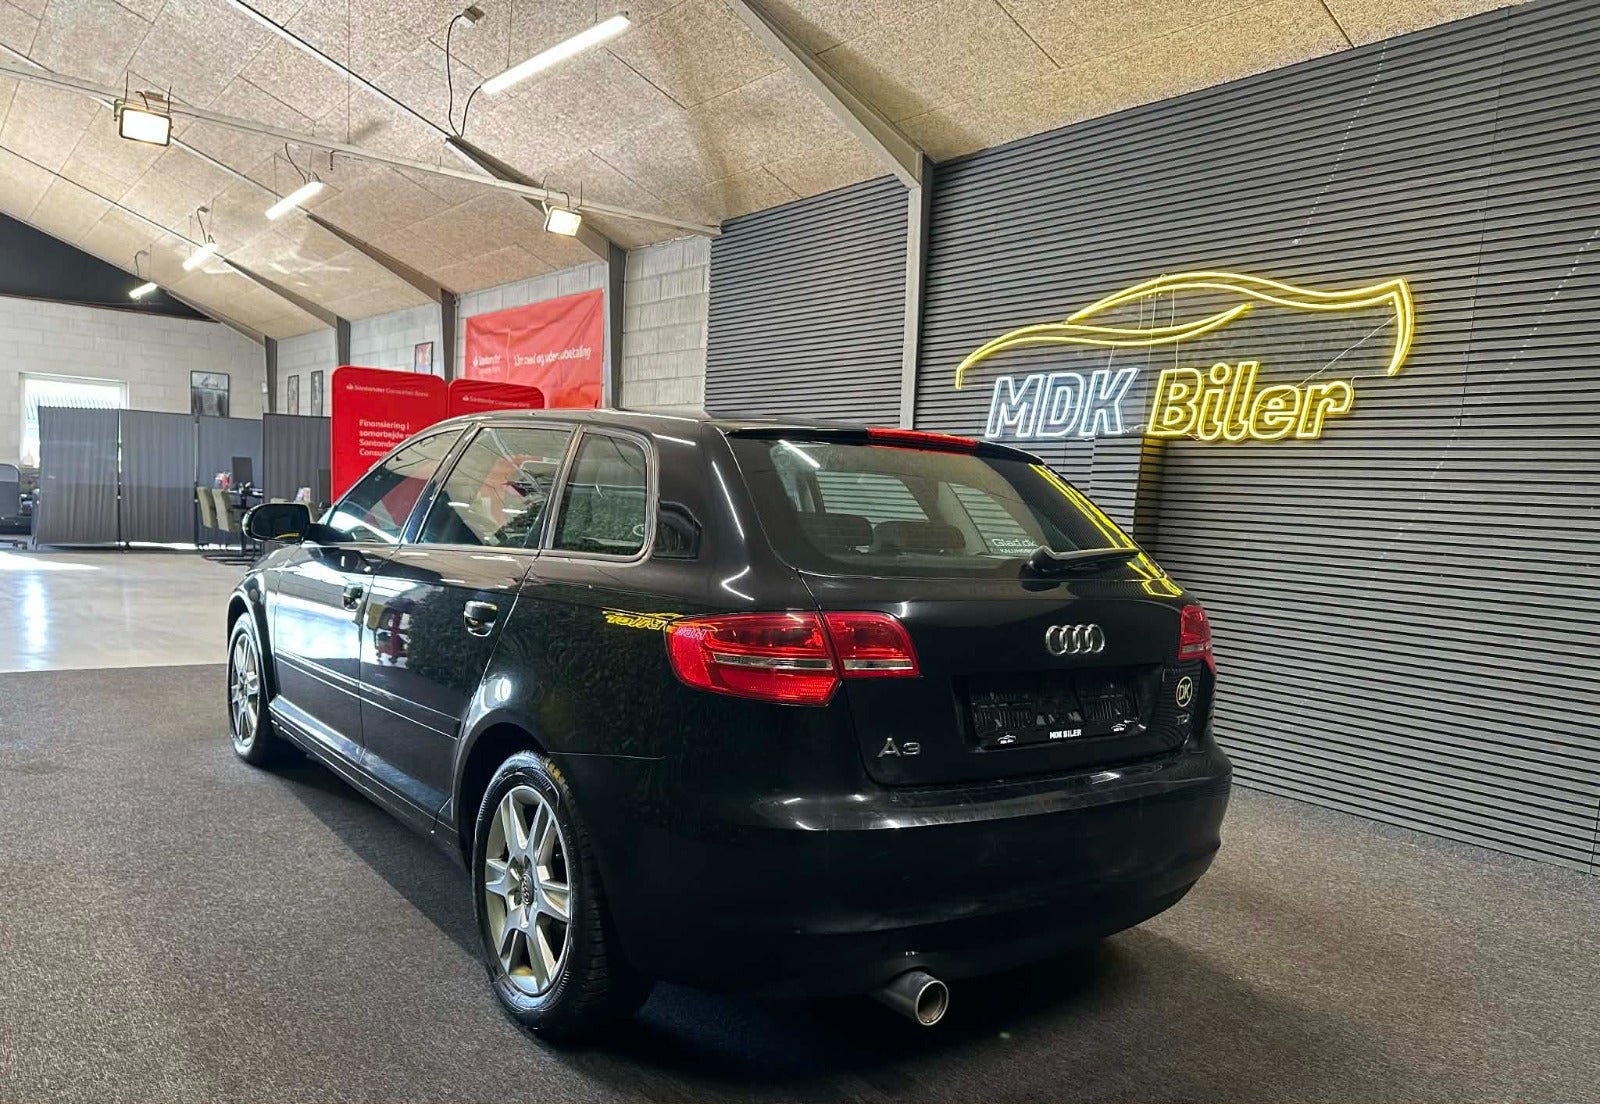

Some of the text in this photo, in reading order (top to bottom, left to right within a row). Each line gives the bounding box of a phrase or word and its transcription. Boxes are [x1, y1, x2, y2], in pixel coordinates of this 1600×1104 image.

[984, 360, 1355, 442] MDK Biler
[359, 419, 405, 431] Finansiering
[359, 430, 404, 440] samarbejde
[359, 438, 396, 448] Santande
[1179, 683, 1191, 701] DK
[1049, 729, 1082, 739] MDK BILER
[877, 737, 920, 757] A3
